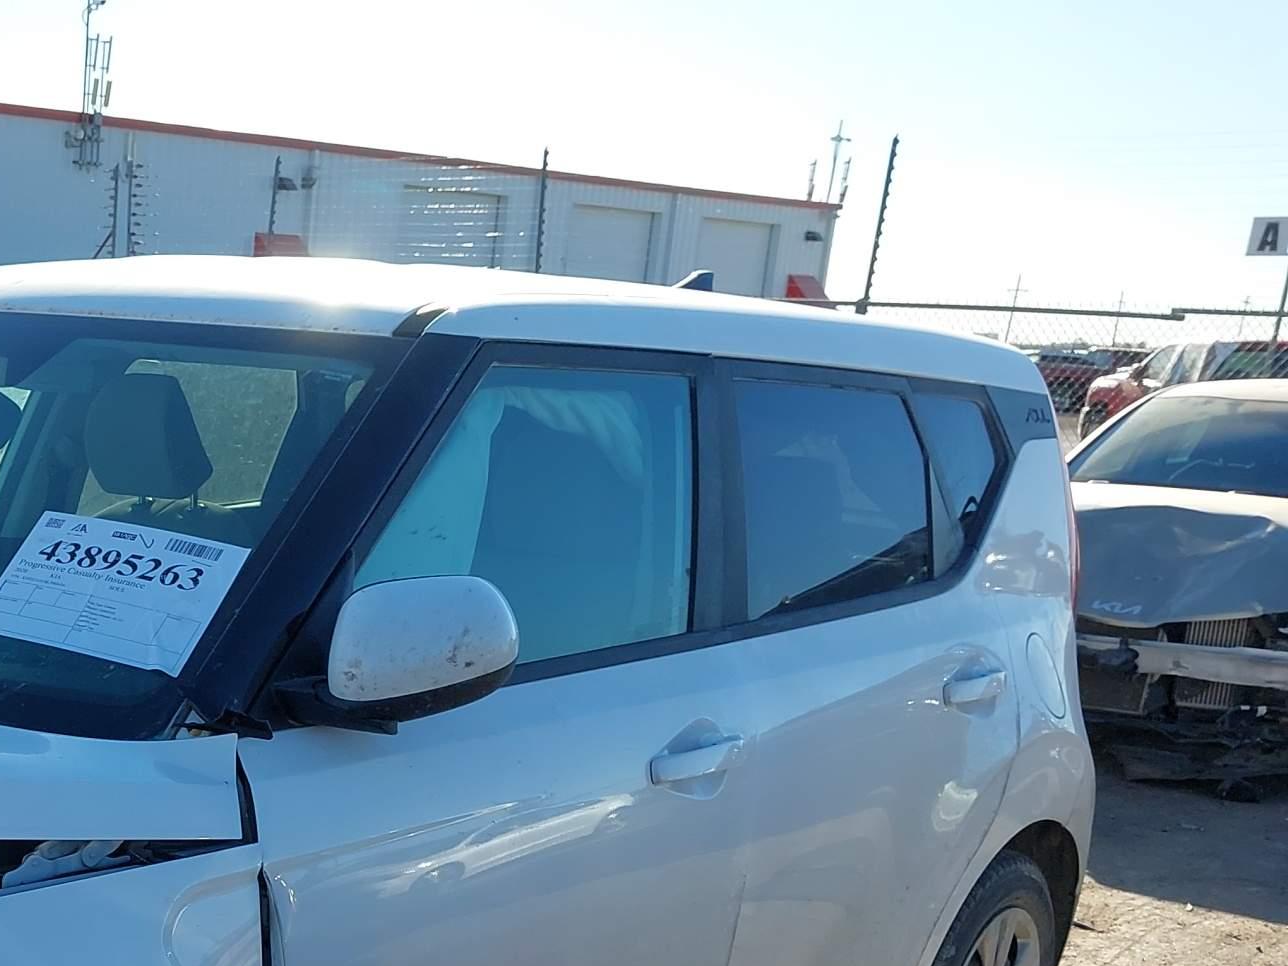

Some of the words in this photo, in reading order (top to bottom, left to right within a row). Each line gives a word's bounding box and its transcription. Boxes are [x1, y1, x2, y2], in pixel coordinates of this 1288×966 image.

[1256, 221, 1279, 251] A
[19, 559, 65, 574] Progressive
[67, 567, 103, 580] Casualty
[105, 573, 146, 590] Insurance
[38, 540, 204, 591] 43895263
